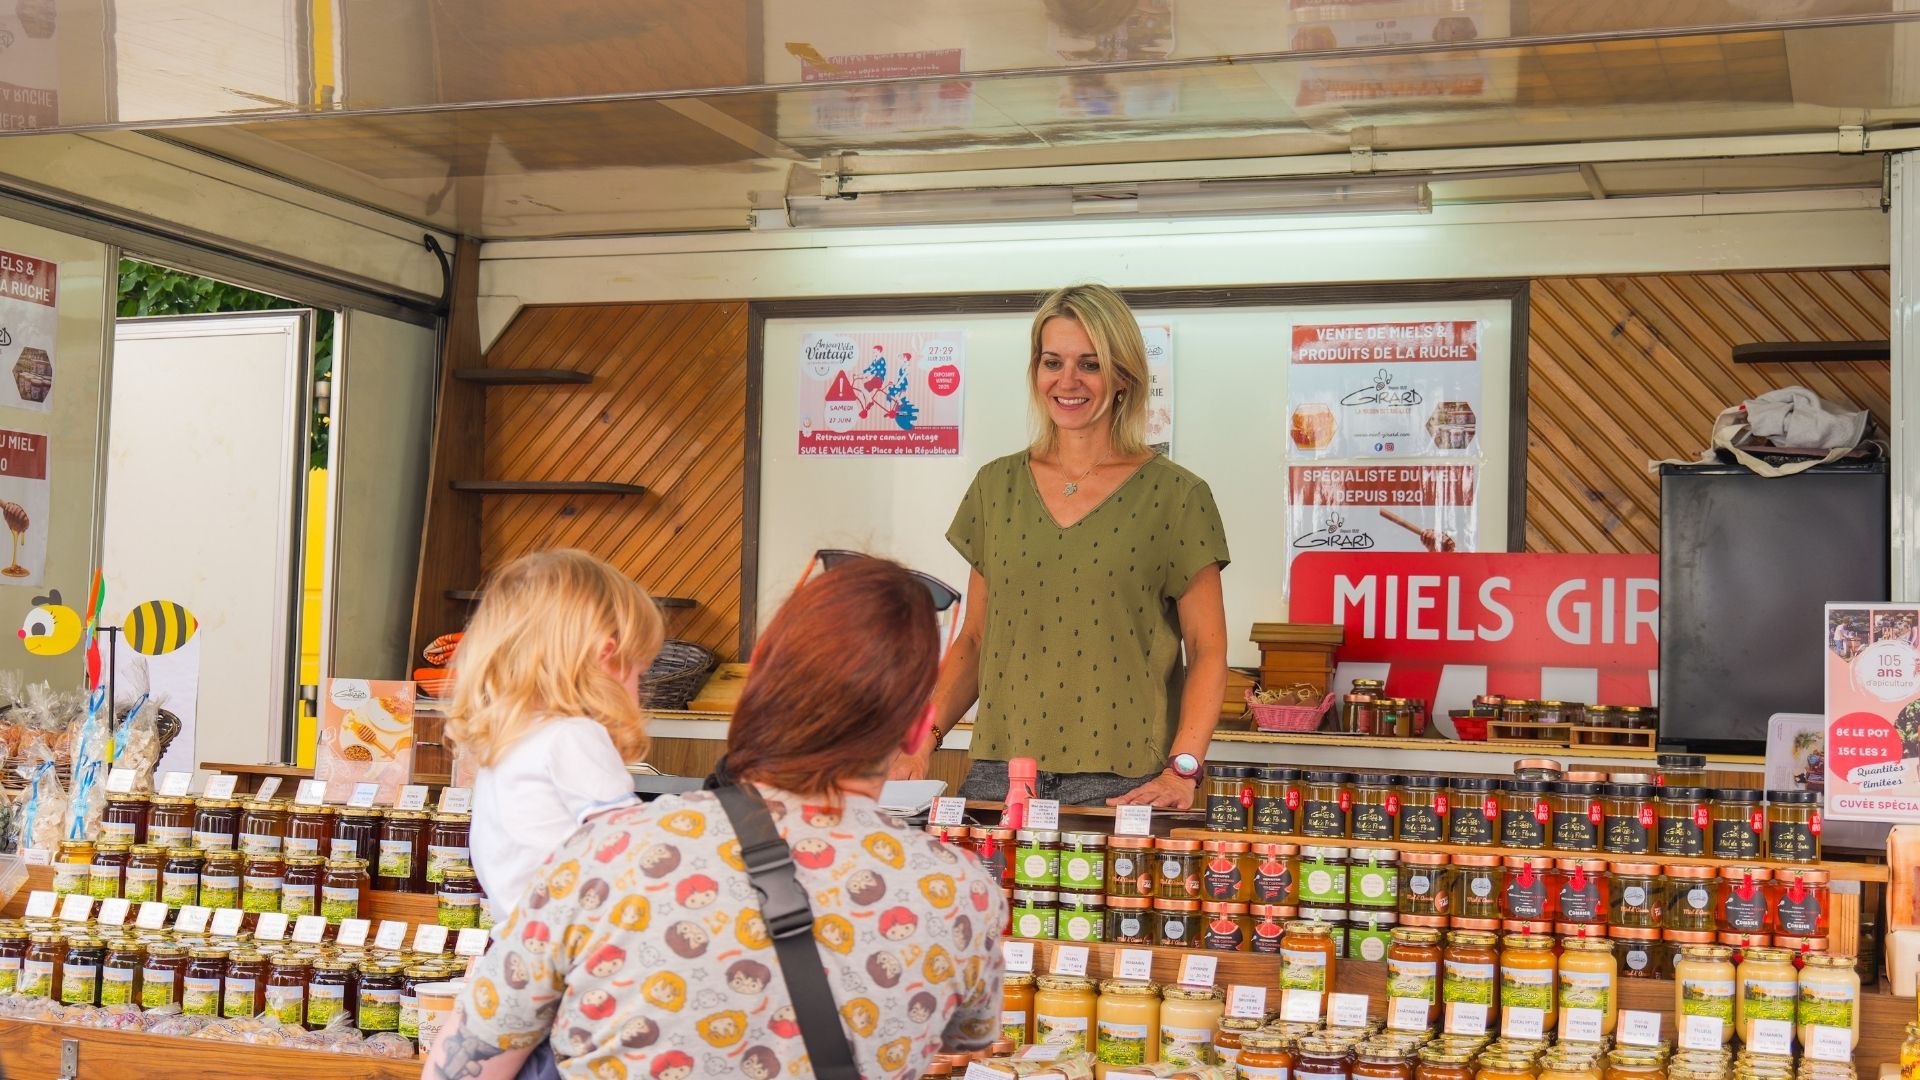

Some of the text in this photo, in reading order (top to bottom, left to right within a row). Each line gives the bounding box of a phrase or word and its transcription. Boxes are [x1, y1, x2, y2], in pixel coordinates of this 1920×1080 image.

[0, 256, 24, 275] ELS
[11, 282, 50, 302] RUCHE
[1316, 325, 1448, 341] VENTE DE MIELS &
[806, 346, 854, 364] Vintage
[1300, 346, 1468, 361] PRODUITS DE LA RUCHE
[1340, 386, 1423, 406] GIRARD
[8, 436, 34, 453] MIEL
[816, 433, 854, 442] Retrouvez
[908, 434, 939, 442] Vintage
[800, 446, 817, 454] SUR
[818, 446, 828, 454] LE
[829, 446, 864, 454] VILLAGE
[872, 446, 893, 454] Place
[894, 446, 904, 454] de
[906, 446, 912, 454] la
[914, 446, 957, 455] République
[0, 458, 8, 472] 0
[1303, 468, 1458, 482] SPÉCIALISTE DU MIEL
[1335, 490, 1423, 502] DEPUIS 1920
[1293, 528, 1374, 550] GIRARD
[1333, 574, 1660, 645] MIELS GIR
[1880, 654, 1901, 666] 105
[1877, 668, 1902, 678] ans
[1866, 680, 1914, 688] d'apiculture
[1836, 728, 1890, 738] 8€ LE POT
[1838, 748, 1888, 757] 15€ LES 2
[1857, 764, 1906, 778] Quantités
[1863, 778, 1904, 790] limitées
[1840, 798, 1920, 811] CUVÉE SPÉCIA
